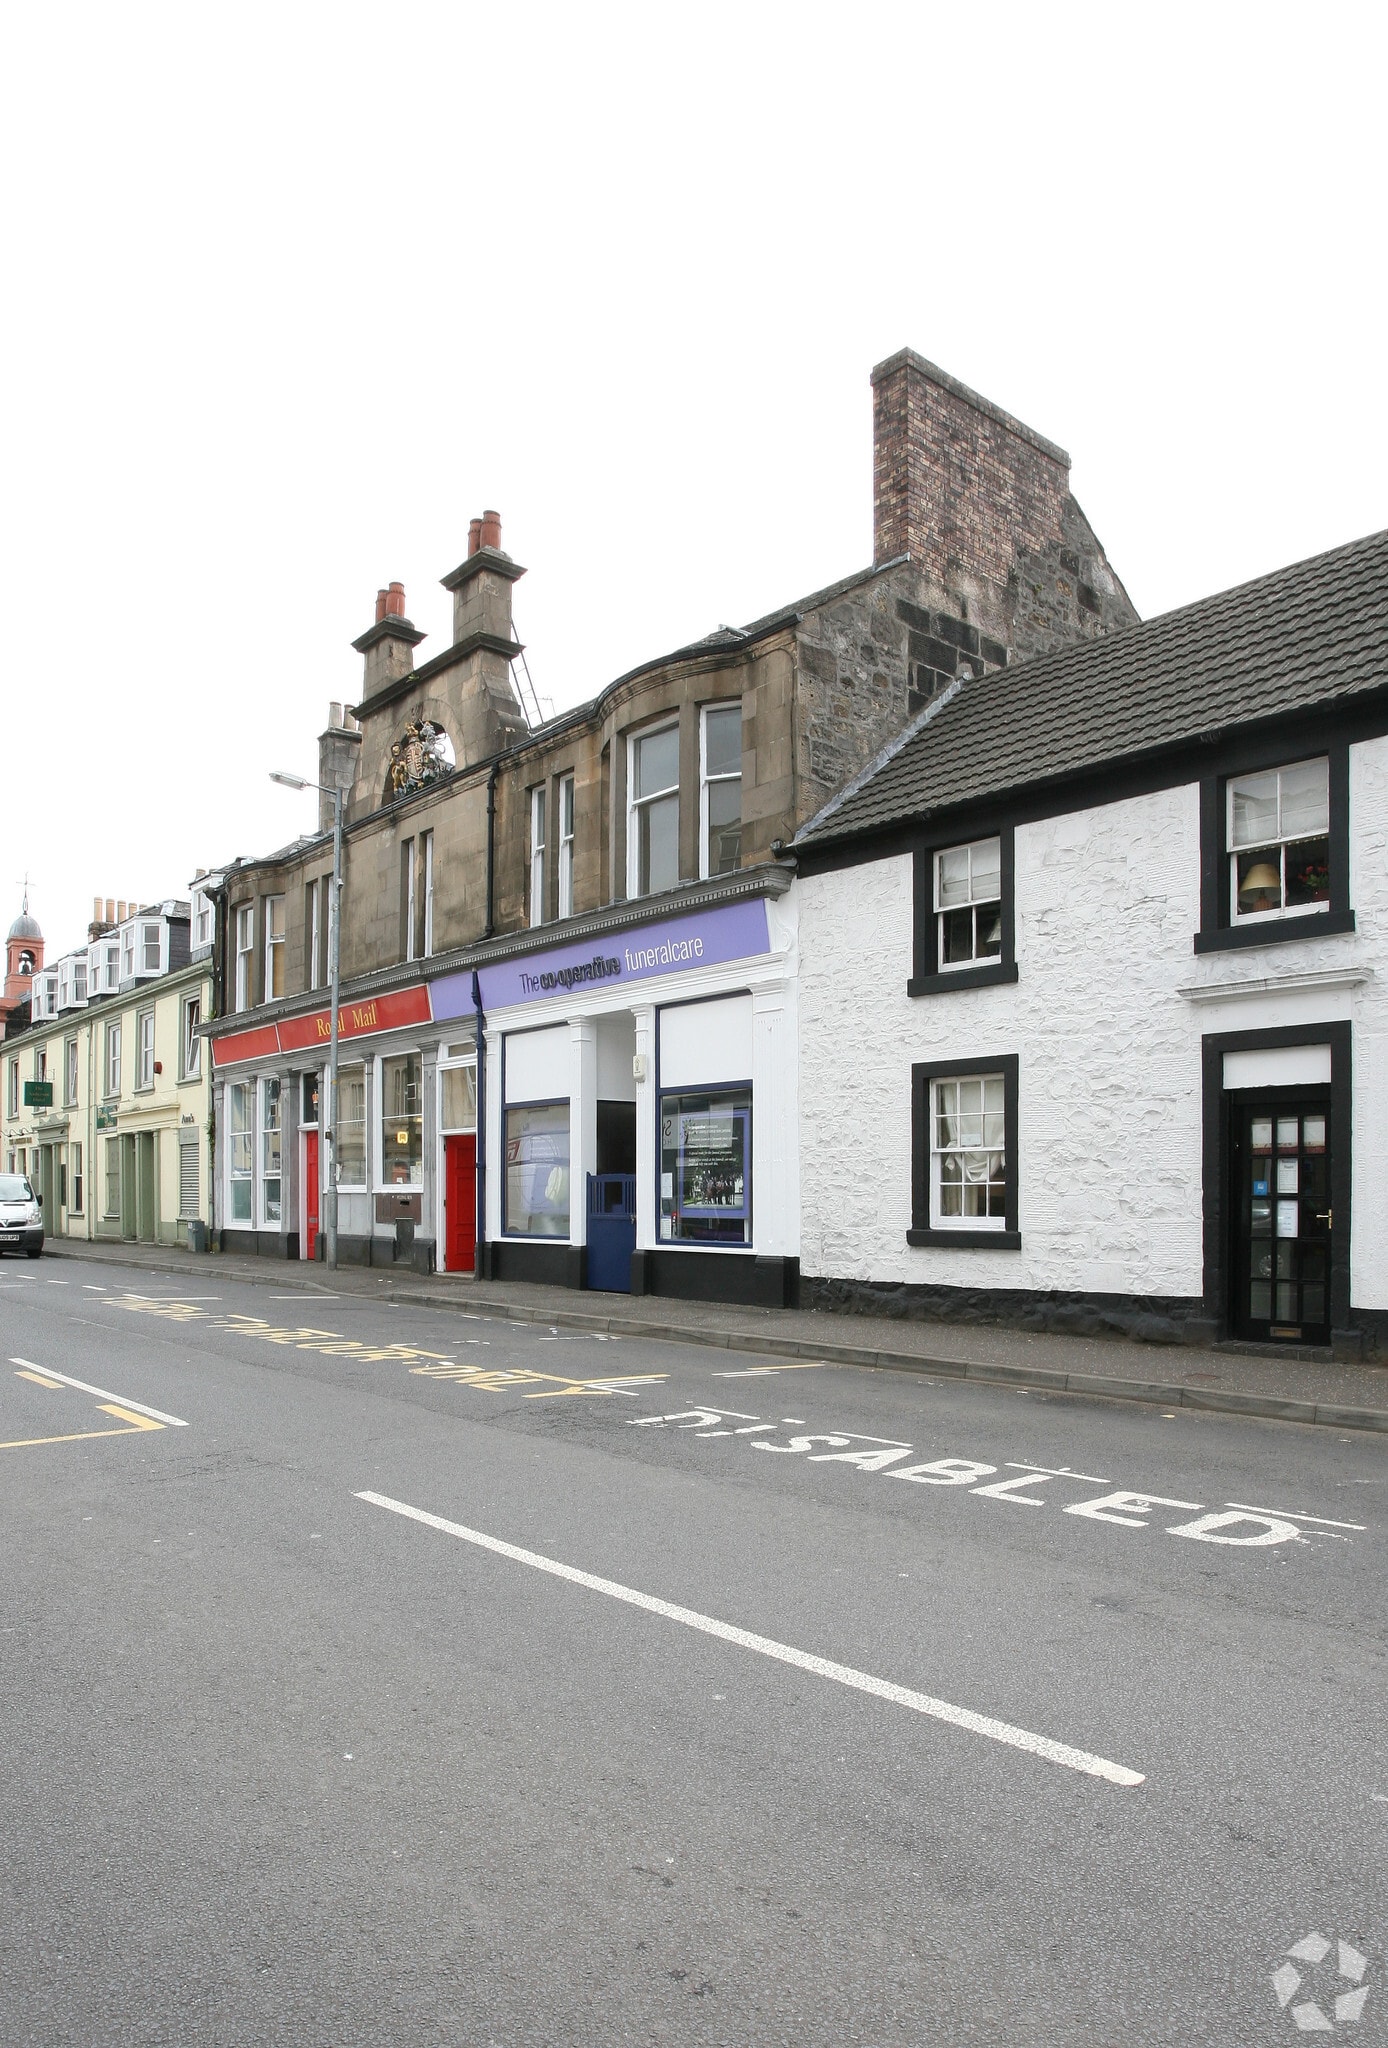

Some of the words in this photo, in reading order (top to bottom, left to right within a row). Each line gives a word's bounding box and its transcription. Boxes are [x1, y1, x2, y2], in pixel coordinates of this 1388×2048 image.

[519, 973, 540, 994] The
[625, 938, 703, 972] funeralcare
[316, 1012, 346, 1037] Roal
[352, 1003, 377, 1029] Mail
[206, 1322, 417, 1362] PARLOUR
[408, 1365, 612, 1399] ONLY
[625, 1410, 1303, 1546] DISABLED
